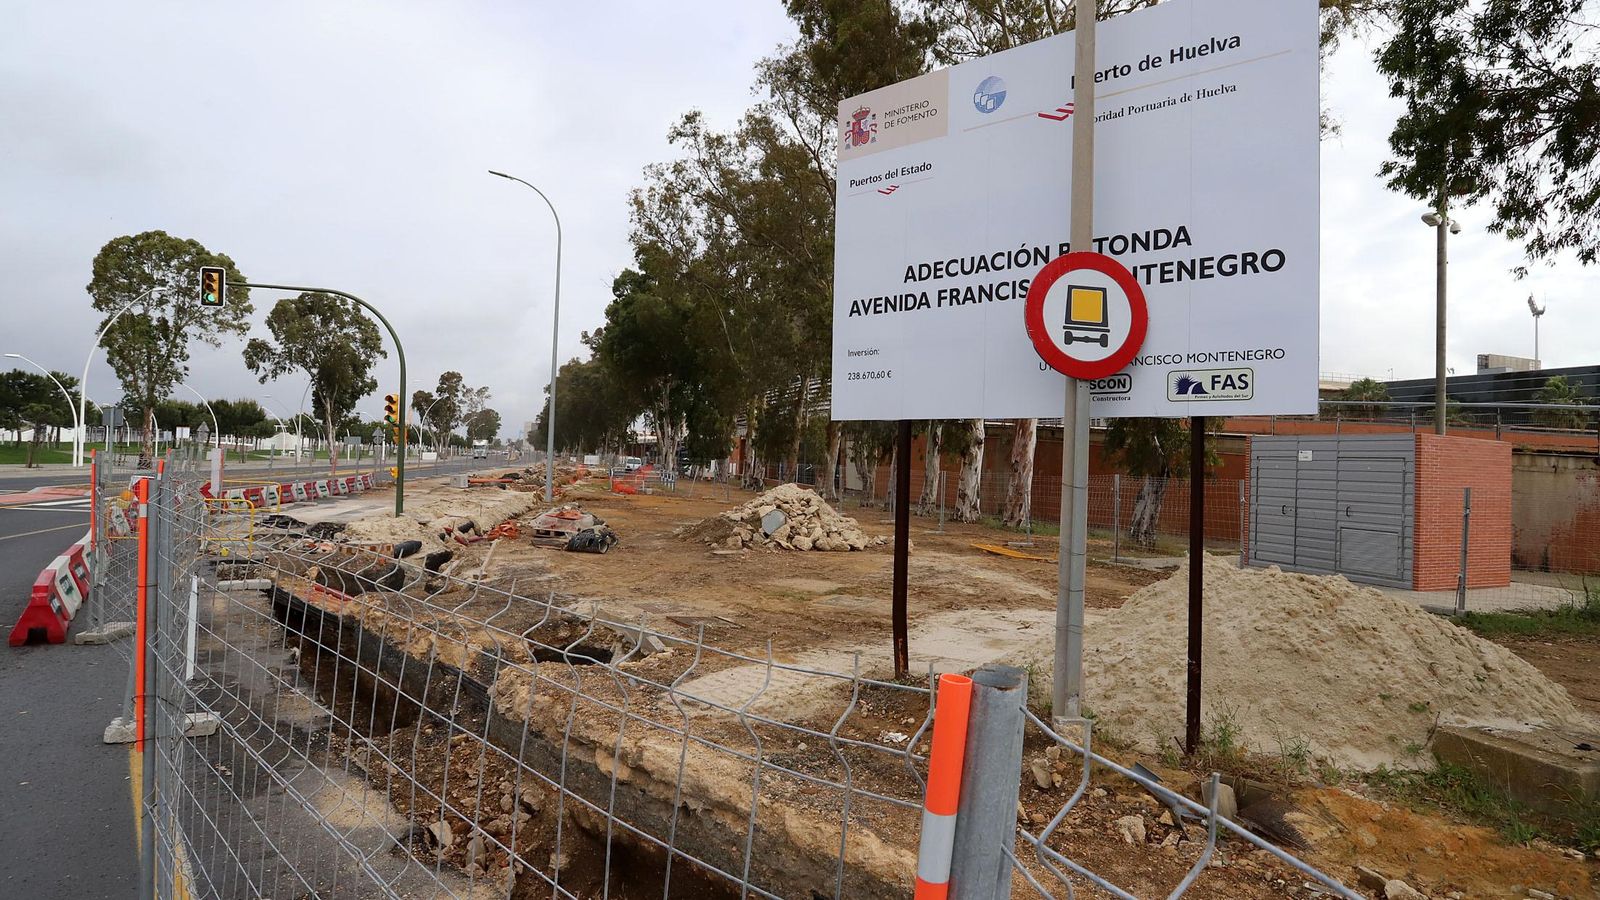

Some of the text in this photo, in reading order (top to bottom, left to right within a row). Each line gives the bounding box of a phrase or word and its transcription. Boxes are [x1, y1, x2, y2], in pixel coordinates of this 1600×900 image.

[1071, 35, 1241, 90] erto de Huelva
[884, 100, 930, 119] MINISTERIO
[1094, 83, 1237, 124] oridad Portuaria de Huelva
[884, 108, 938, 130] DE FOMENTO
[849, 162, 932, 188] Puertos del Estado
[903, 225, 1192, 283] ADECUACIÓN RTONDA
[848, 248, 1286, 317] AVENIDA FRANCIS TENEGRO
[847, 347, 880, 357] Inversión:
[1186, 348, 1285, 364] MONTENEGRO
[847, 369, 892, 381] 238.670,60 €
[1211, 373, 1249, 391] FAS
